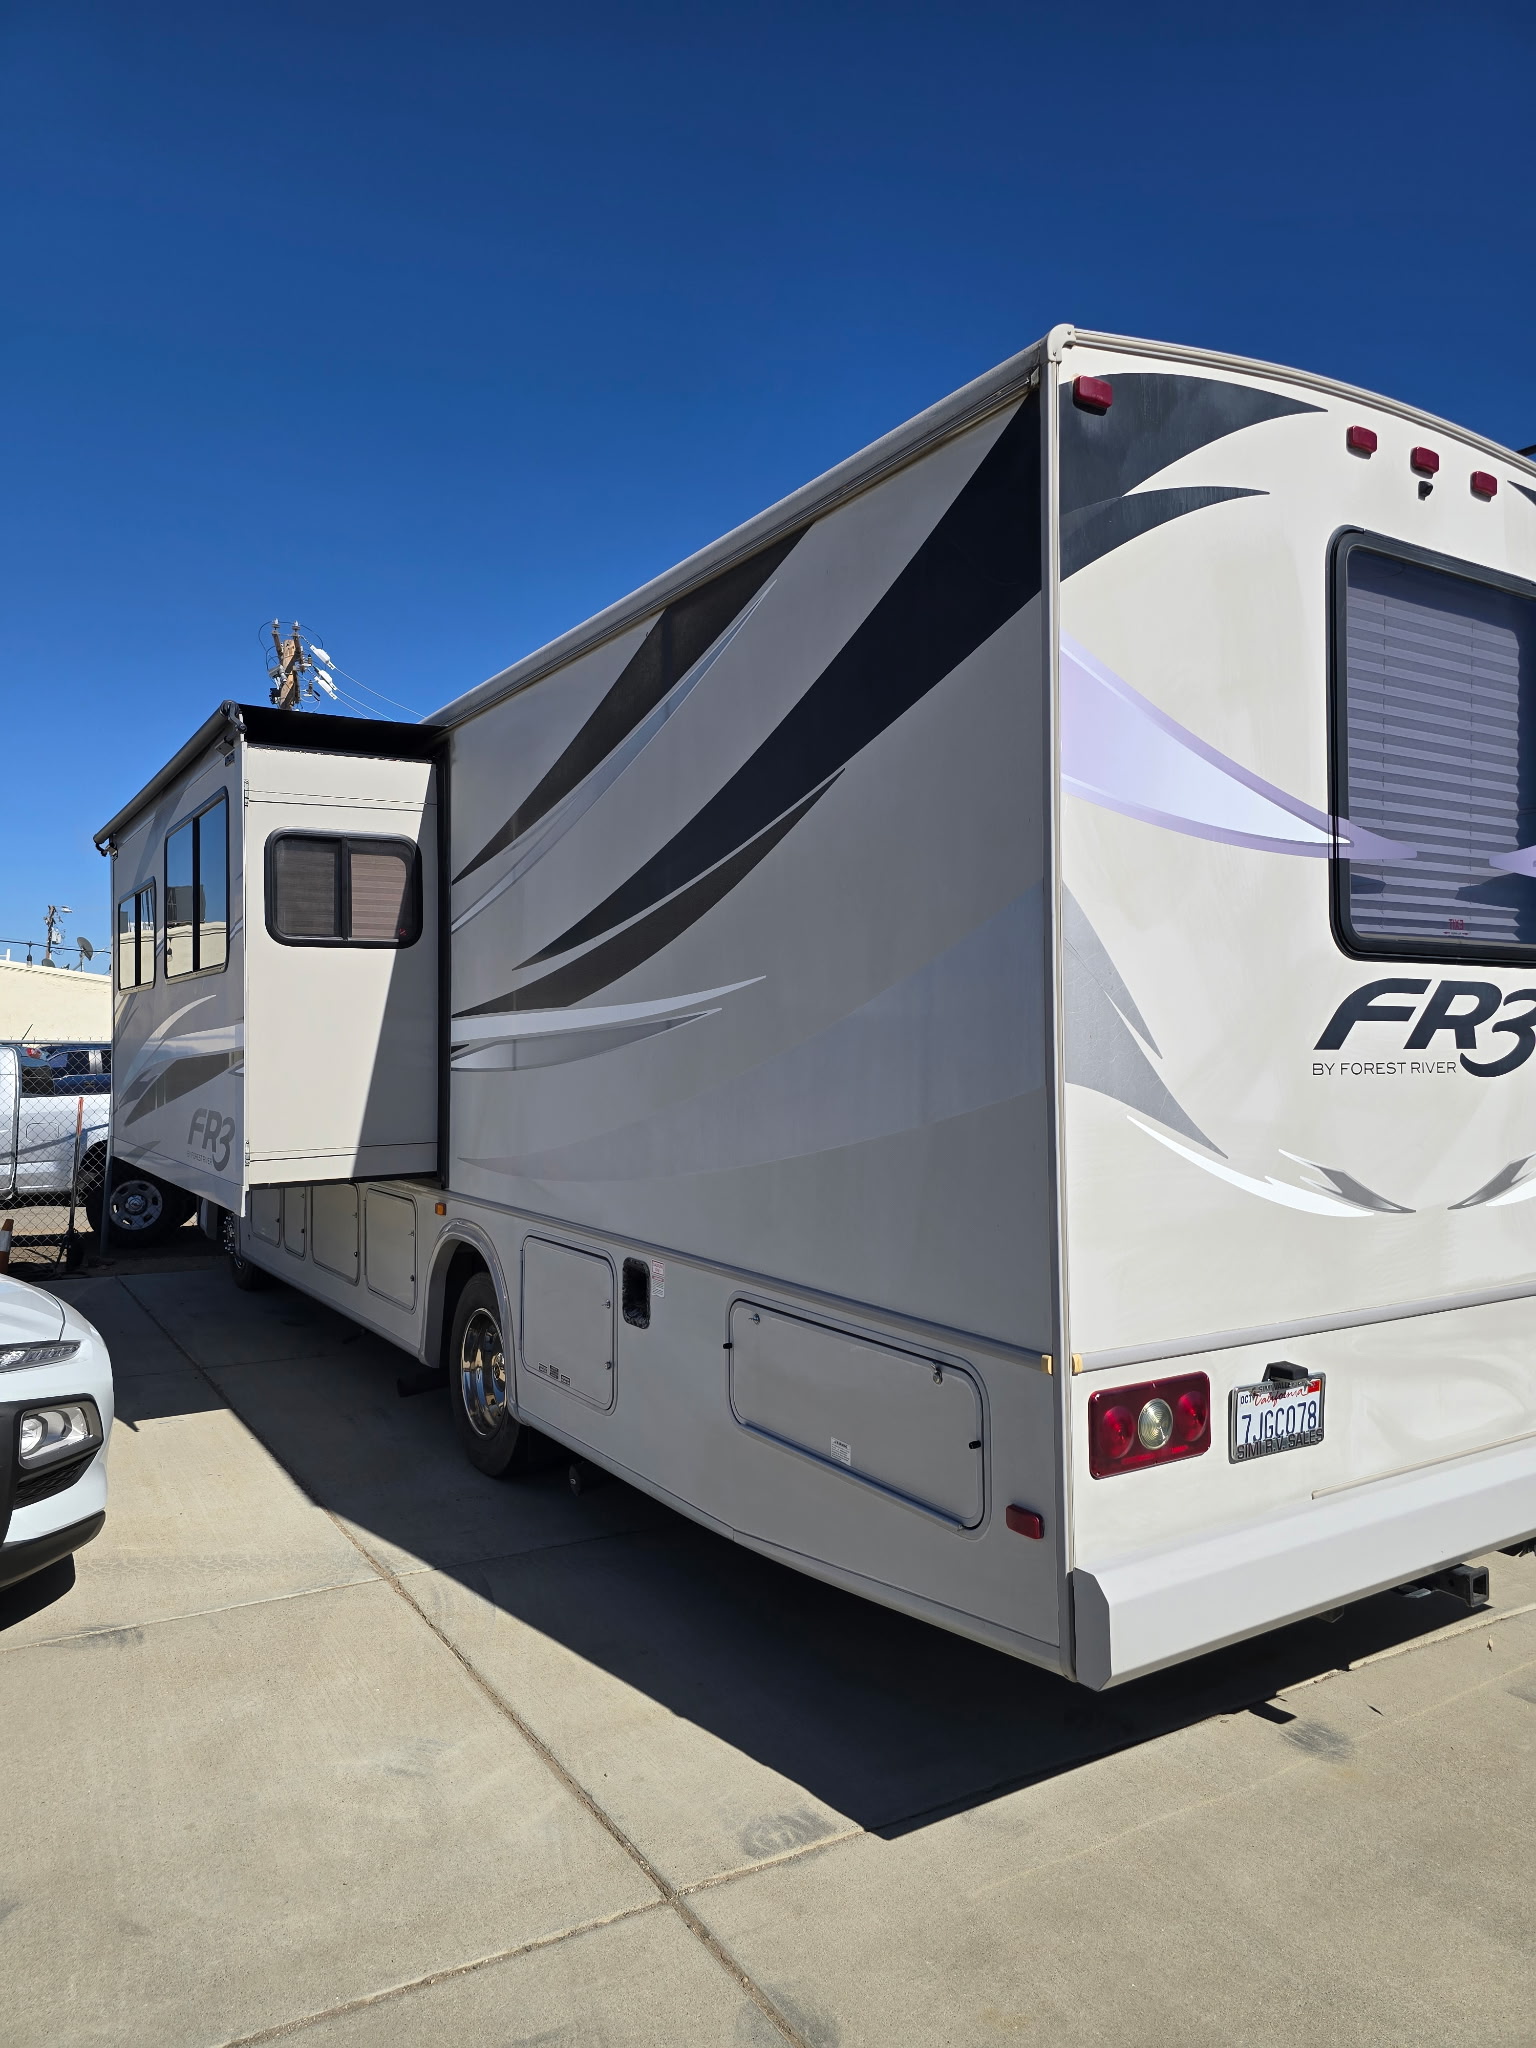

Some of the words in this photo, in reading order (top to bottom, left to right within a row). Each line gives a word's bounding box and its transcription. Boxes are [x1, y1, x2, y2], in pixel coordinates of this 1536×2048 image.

[1313, 977, 1536, 1078] FR3
[1312, 1062, 1335, 1076] BY
[1340, 1062, 1406, 1075] FOREST
[1410, 1061, 1457, 1074] RIVER
[187, 1108, 236, 1172] FR3
[1241, 1400, 1317, 1443] 7JGC078
[1237, 1440, 1262, 1460] SIMI
[1265, 1436, 1285, 1454] R.V.
[1288, 1428, 1323, 1448] SALES
